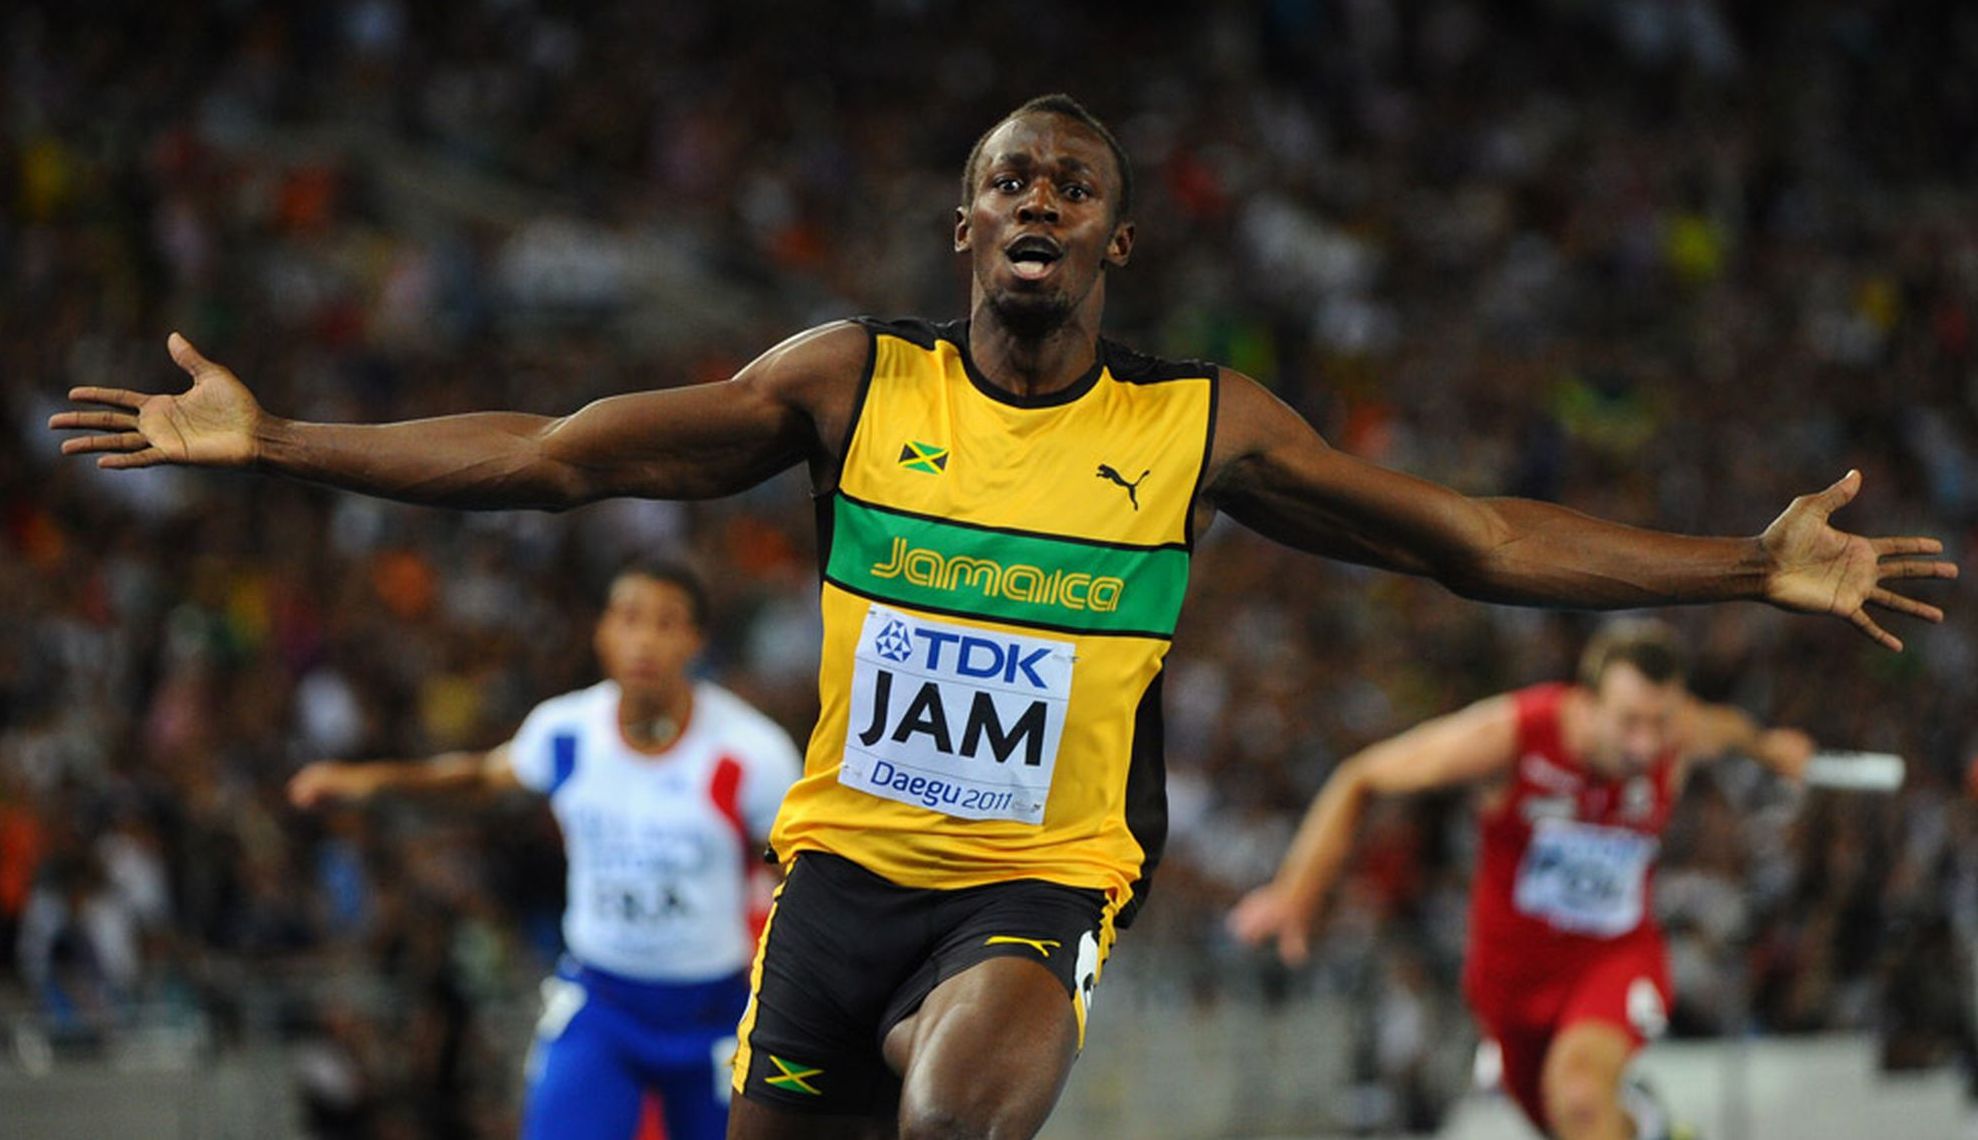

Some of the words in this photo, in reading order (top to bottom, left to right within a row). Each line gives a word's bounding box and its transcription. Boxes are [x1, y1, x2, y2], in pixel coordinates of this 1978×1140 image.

[870, 536, 1124, 612] Jamaica
[914, 627, 1052, 690] TDK
[859, 669, 1048, 767] JAM
[869, 760, 960, 808] Daegu
[961, 788, 1014, 811] 2011
